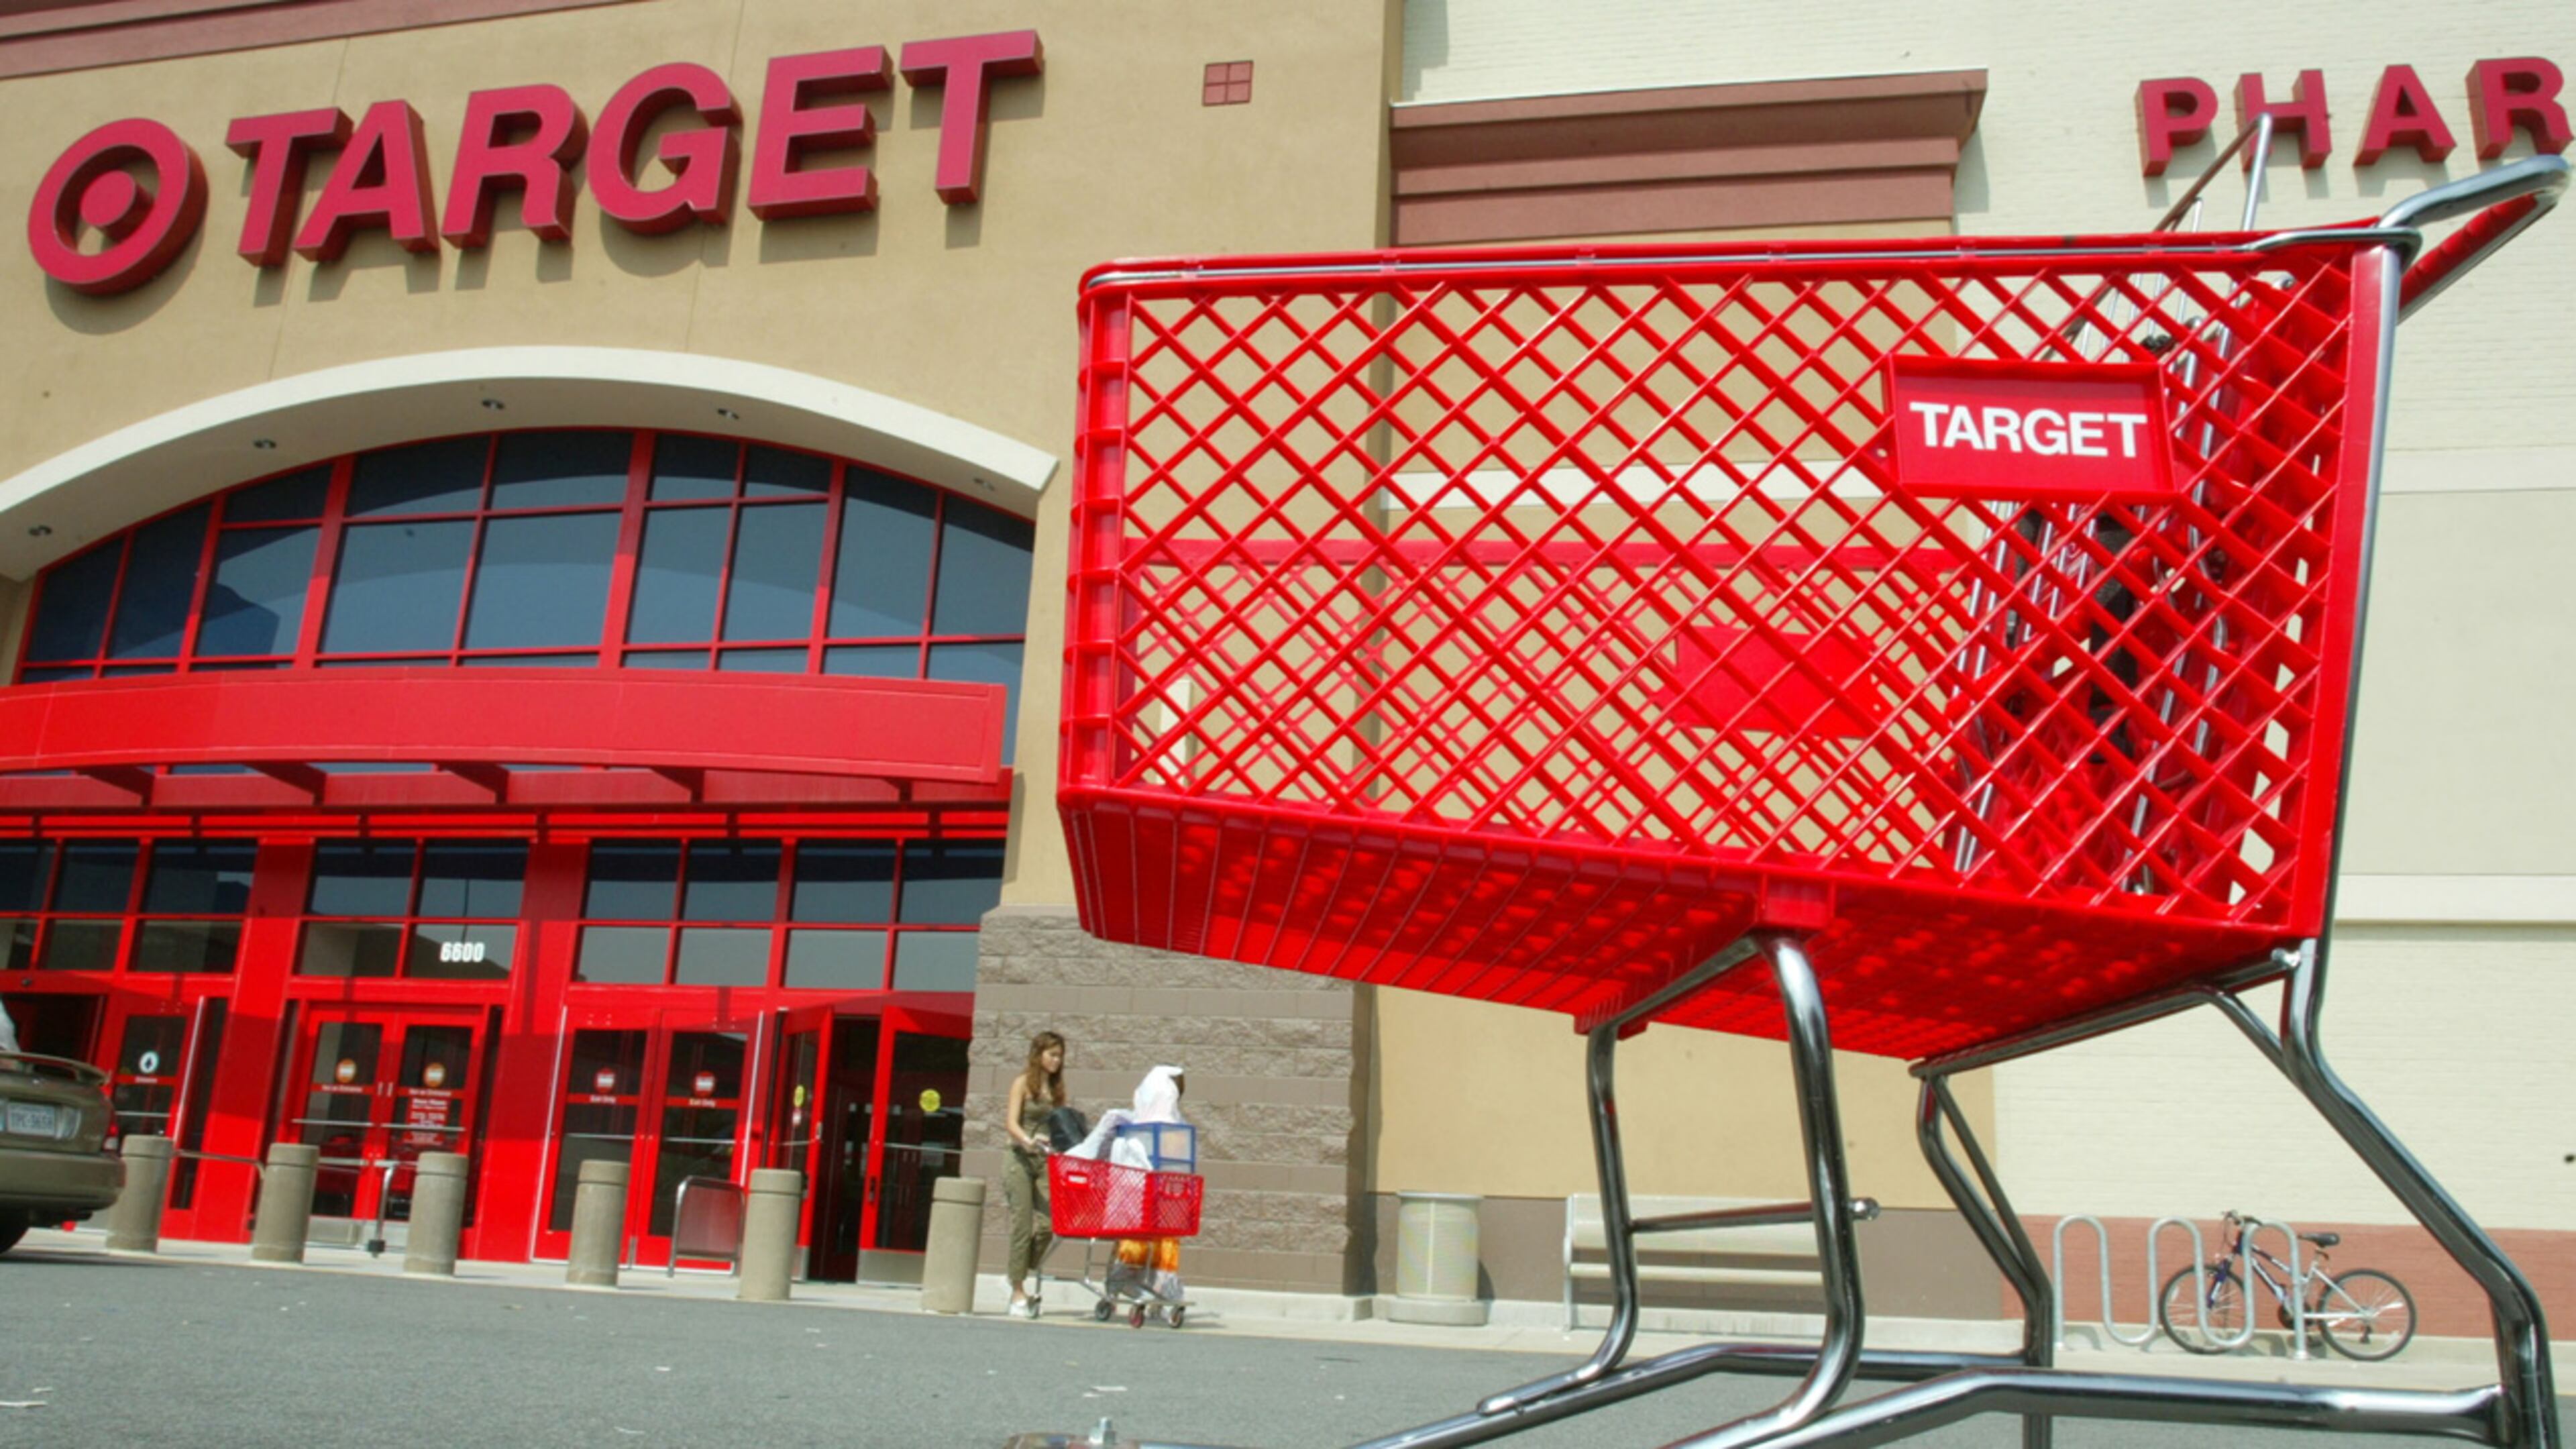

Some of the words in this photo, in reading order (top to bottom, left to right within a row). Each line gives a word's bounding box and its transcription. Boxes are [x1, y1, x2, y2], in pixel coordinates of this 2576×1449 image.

[225, 29, 1043, 267] TARGET
[2135, 56, 2574, 177] PHAR
[1909, 401, 2147, 458] TARGET
[440, 942, 484, 963] 6600
